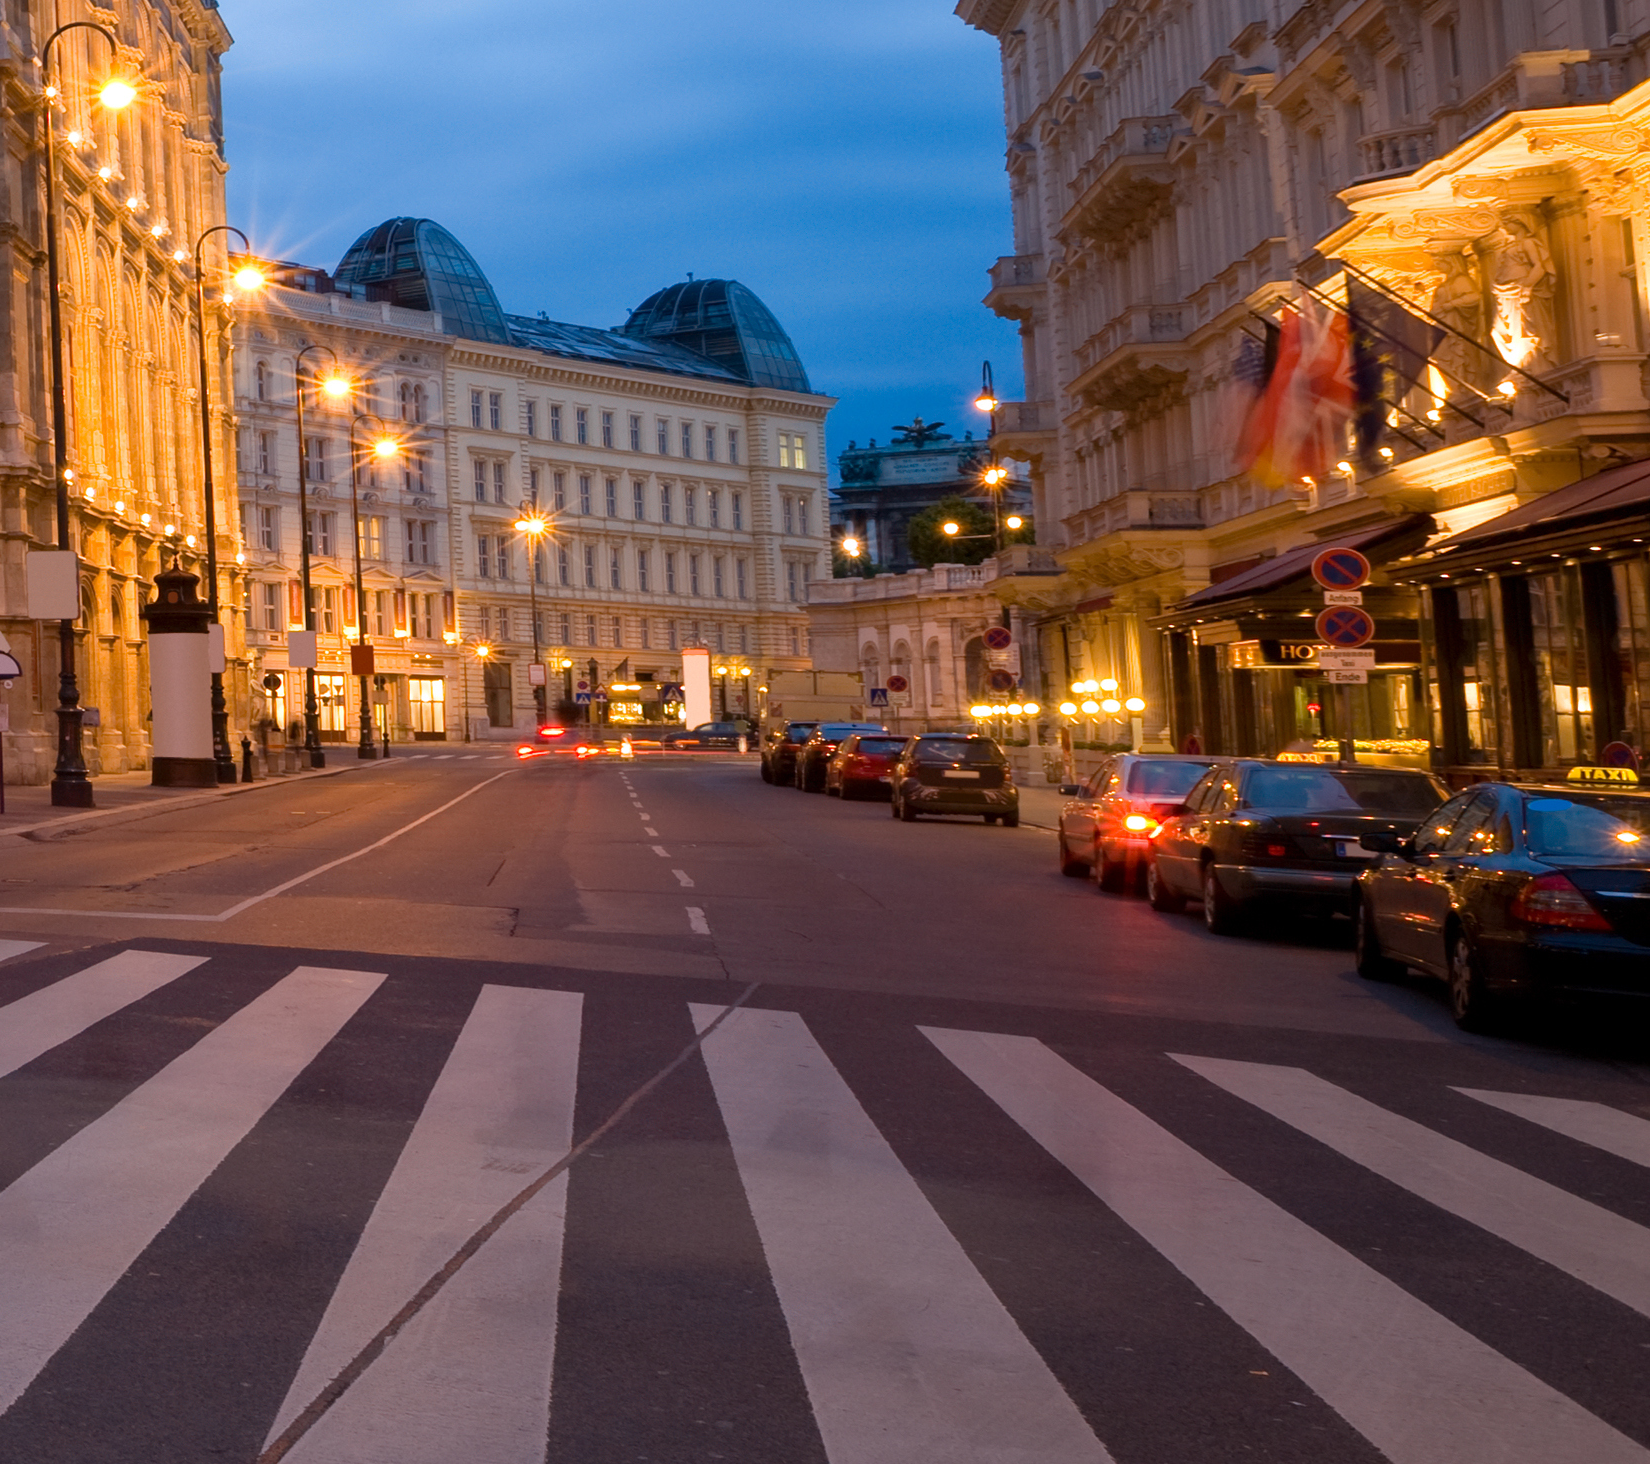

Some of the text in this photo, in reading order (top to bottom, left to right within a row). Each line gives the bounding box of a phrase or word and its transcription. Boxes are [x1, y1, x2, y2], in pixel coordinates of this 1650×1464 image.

[1328, 594, 1359, 604] Anfang
[1320, 650, 1373, 659] ausgenommen
[1340, 659, 1356, 667] Taxi
[1335, 672, 1361, 681] Ende
[1581, 768, 1628, 781] TAXI
